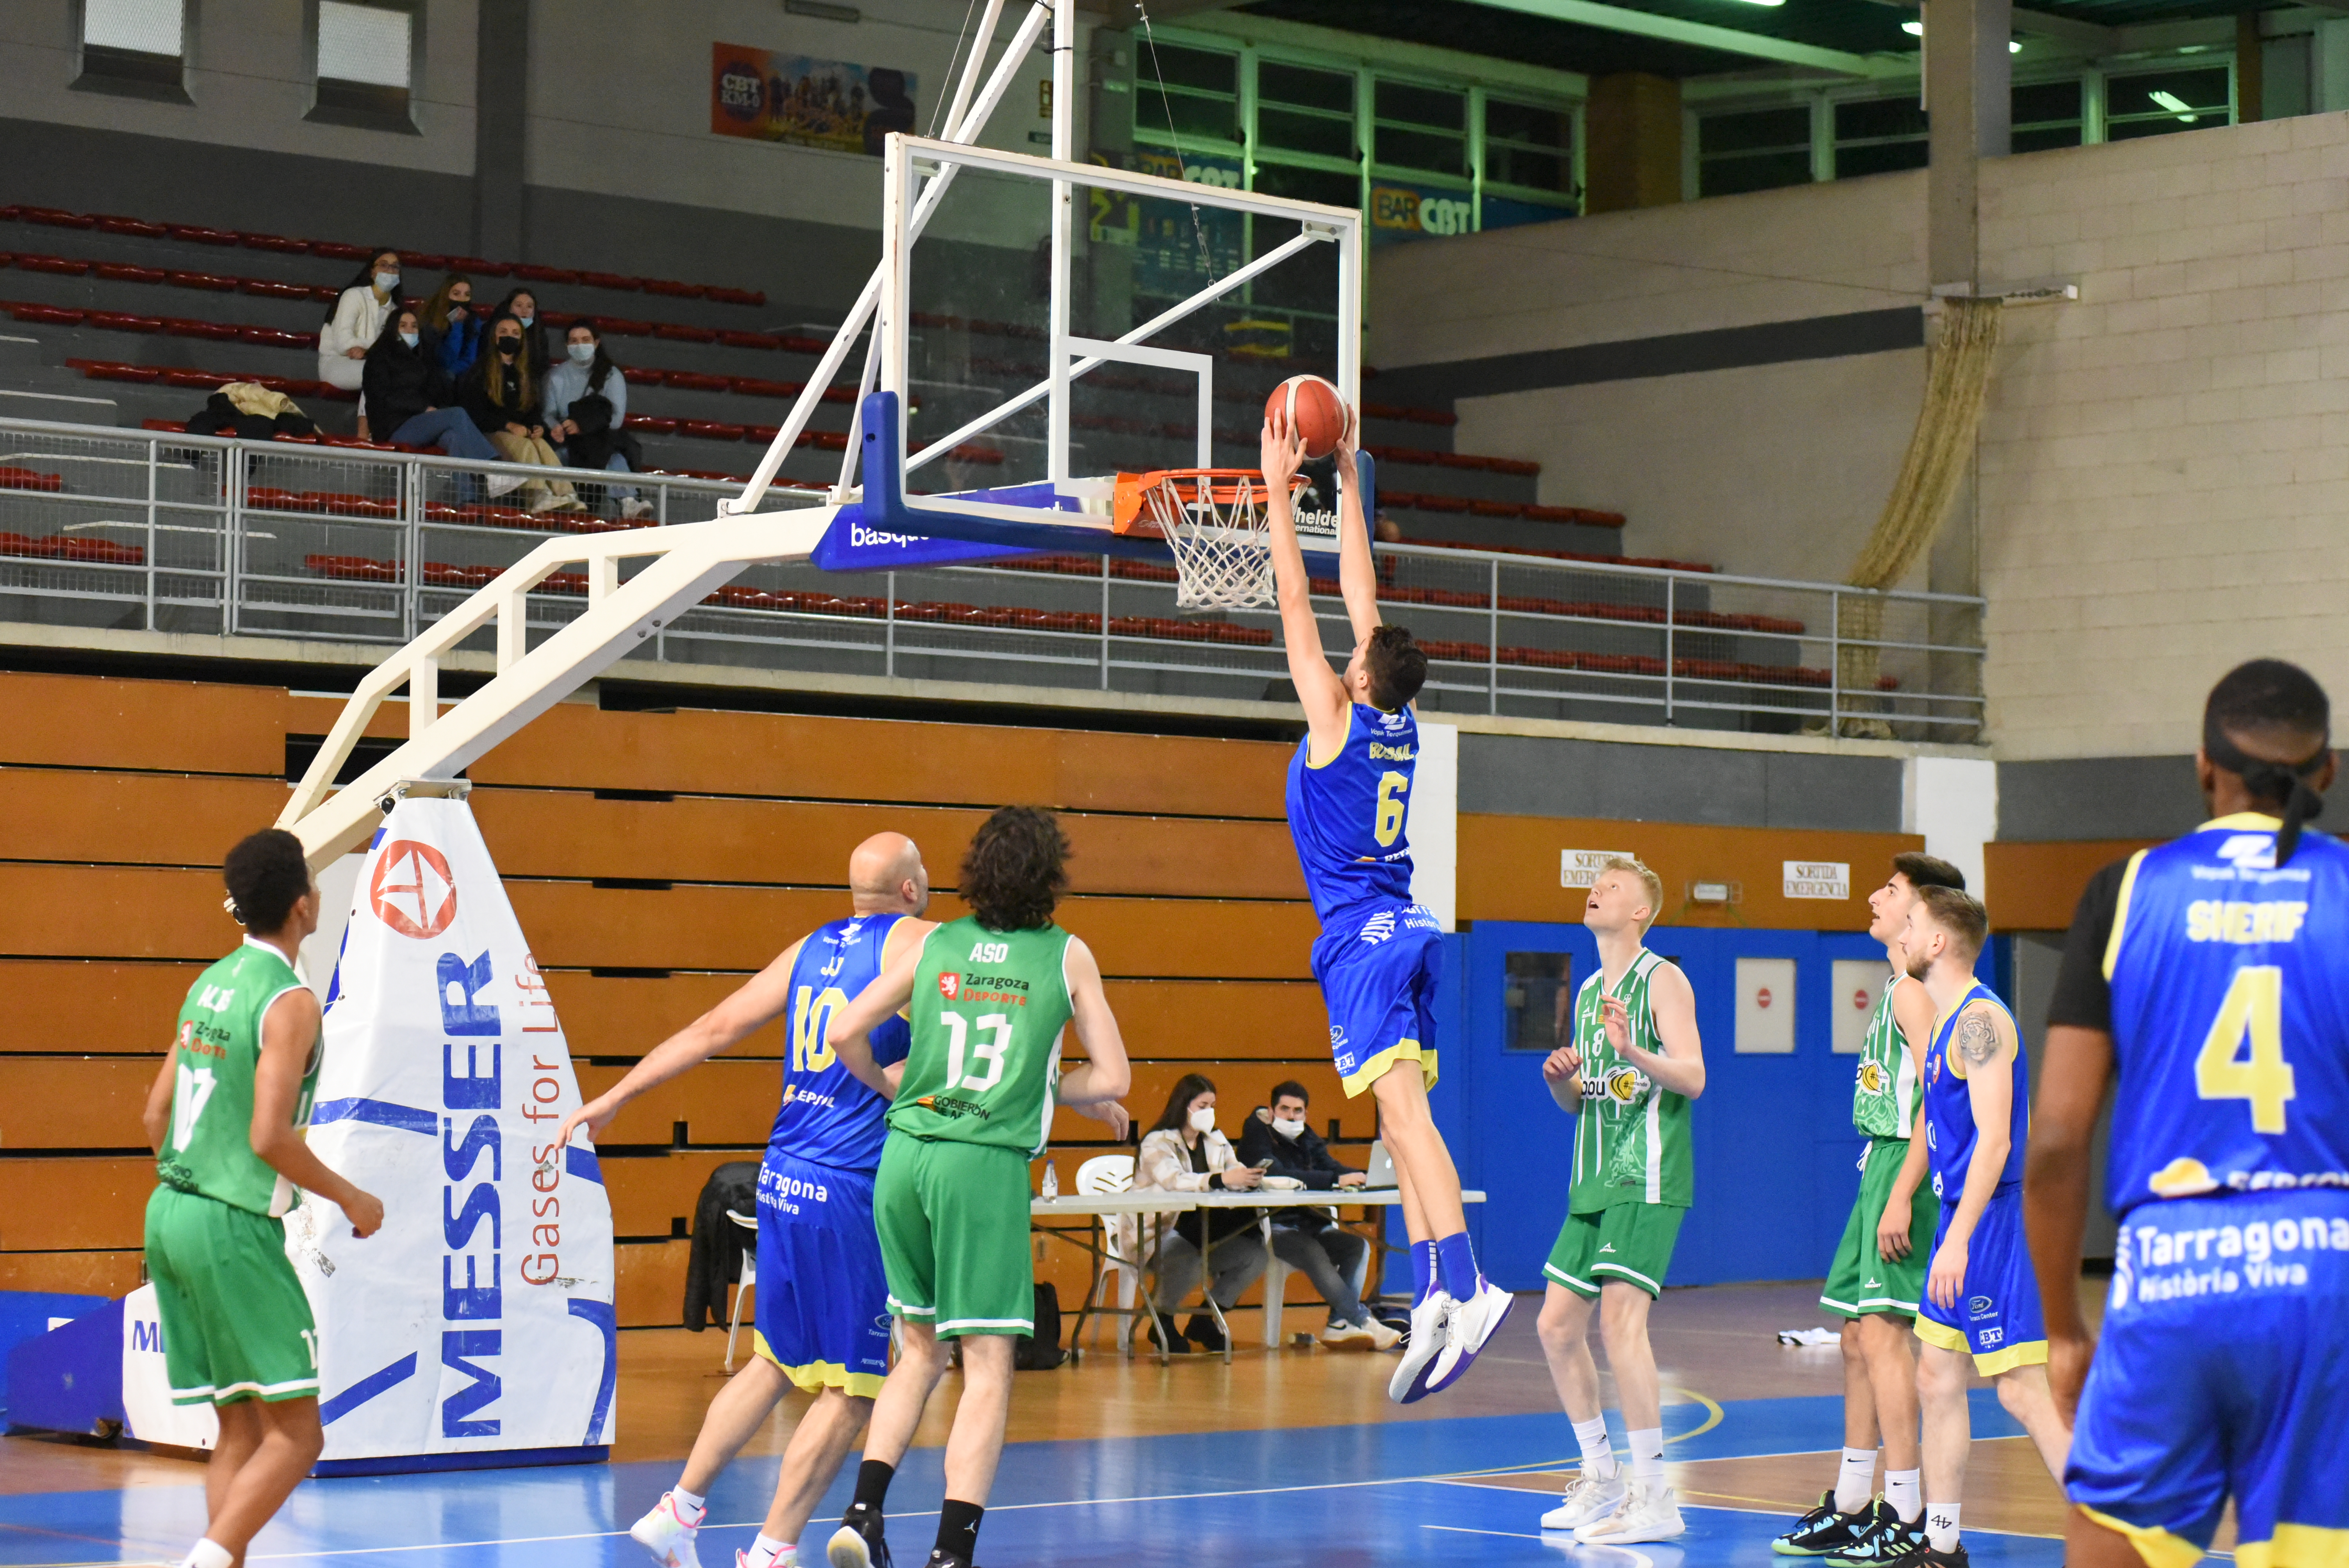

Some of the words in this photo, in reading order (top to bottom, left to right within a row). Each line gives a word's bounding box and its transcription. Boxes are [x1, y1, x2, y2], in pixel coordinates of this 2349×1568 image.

[722, 74, 760, 93] CBT
[1379, 195, 1419, 223] BAR
[1419, 197, 1470, 235] CBT
[1374, 771, 1408, 847] 6
[2187, 899, 2309, 943] SHERIF
[821, 956, 845, 976] JJ
[969, 943, 1009, 964] ASO
[966, 973, 1029, 991] Zaragoza
[793, 985, 849, 1073] 10
[1592, 1028, 1606, 1057] 8
[941, 1011, 1013, 1092] 13
[2195, 965, 2296, 1135] 4
[522, 1054, 560, 1124] for
[437, 948, 502, 1439] MESSER
[778, 1197, 799, 1215] Viva
[521, 1142, 560, 1286] Gases
[2136, 1216, 2349, 1268] Tarragona
[2244, 1260, 2308, 1288] Viva
[868, 1329, 889, 1338] Tarraco
[1980, 1311, 1998, 1320] Center
